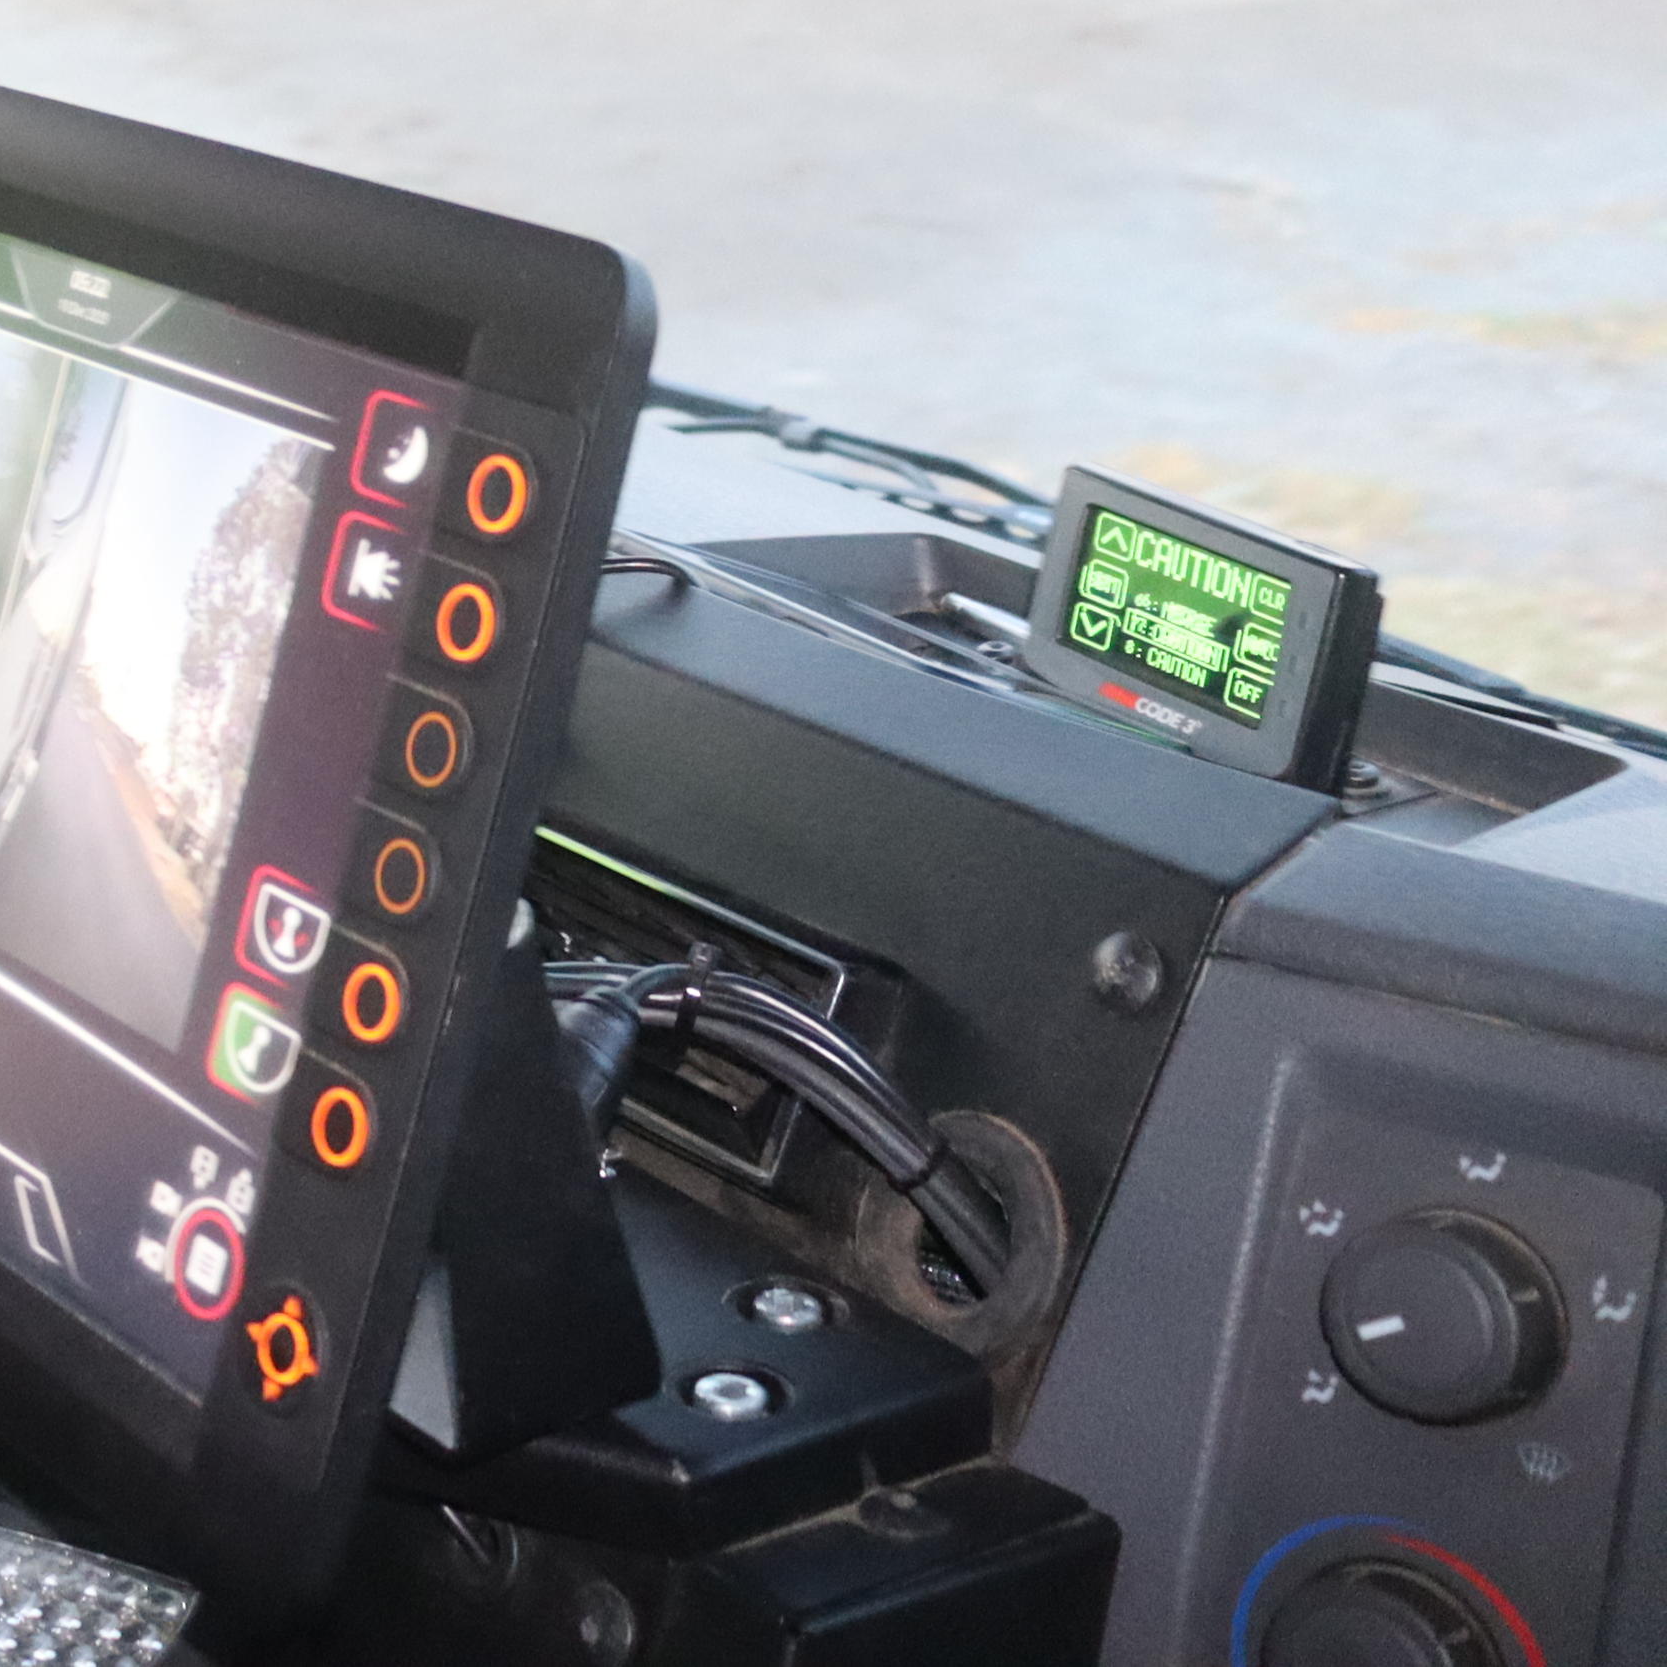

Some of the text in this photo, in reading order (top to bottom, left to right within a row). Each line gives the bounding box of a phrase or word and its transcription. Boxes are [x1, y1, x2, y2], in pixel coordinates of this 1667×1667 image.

[1134, 531, 1253, 608] CAUTION
[1258, 586, 1286, 612] CLR
[1146, 646, 1208, 688] CAUTION
[1232, 679, 1263, 704] OFF
[1134, 697, 1186, 729] CODE
